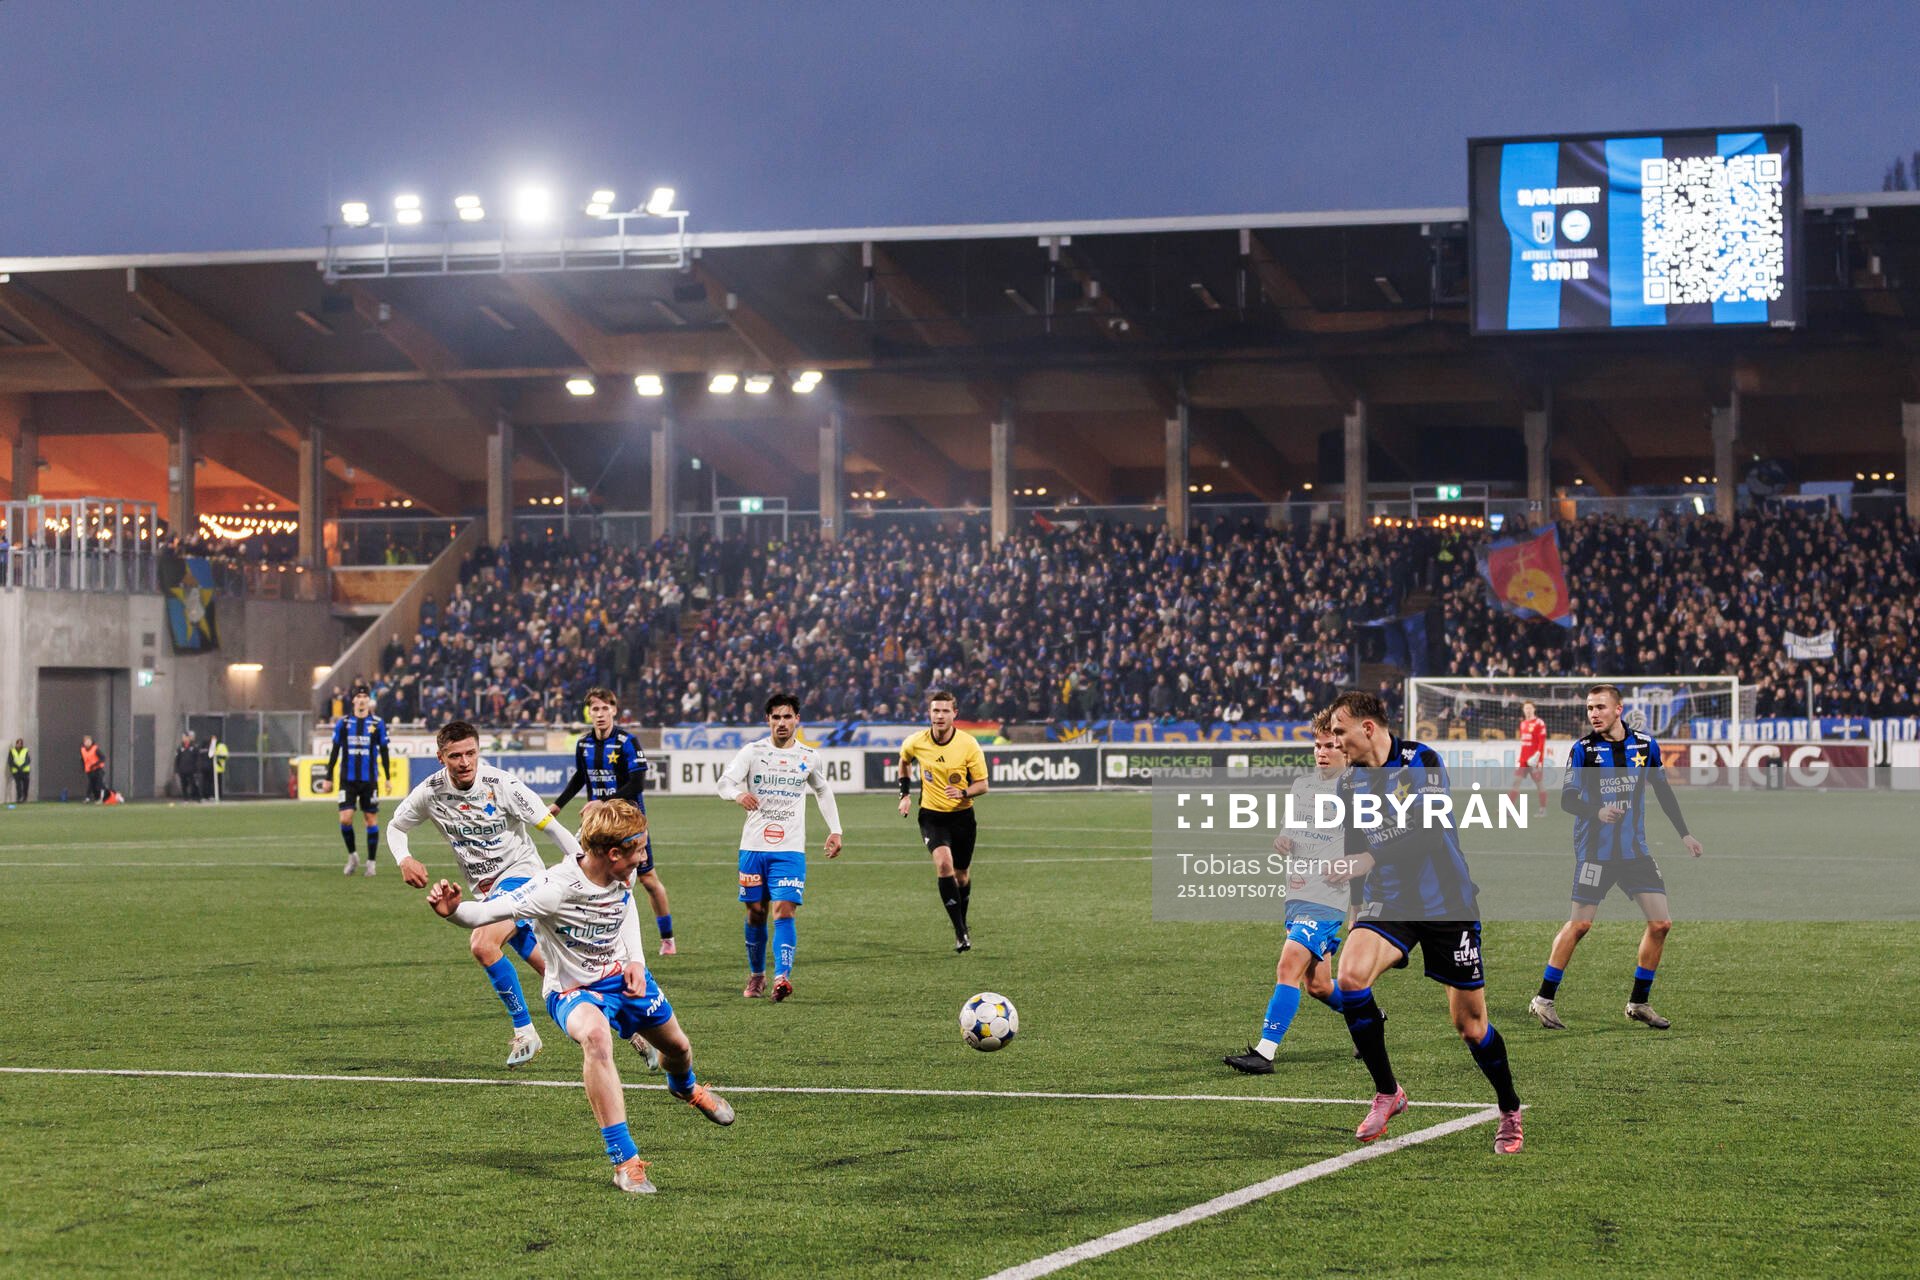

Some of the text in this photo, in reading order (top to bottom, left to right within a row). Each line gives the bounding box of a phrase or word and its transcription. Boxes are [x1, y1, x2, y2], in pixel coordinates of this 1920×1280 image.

[1130, 755, 1212, 767] SNICKERI
[1252, 755, 1317, 766] SNICKE
[683, 763, 705, 783] BT
[827, 761, 851, 781] AB
[992, 756, 1080, 782] inkClub
[1130, 767, 1213, 779] PORTALEN
[1252, 767, 1315, 778] PORTAL
[763, 774, 803, 787] Liljeda
[1600, 784, 1635, 794] CONSTRU
